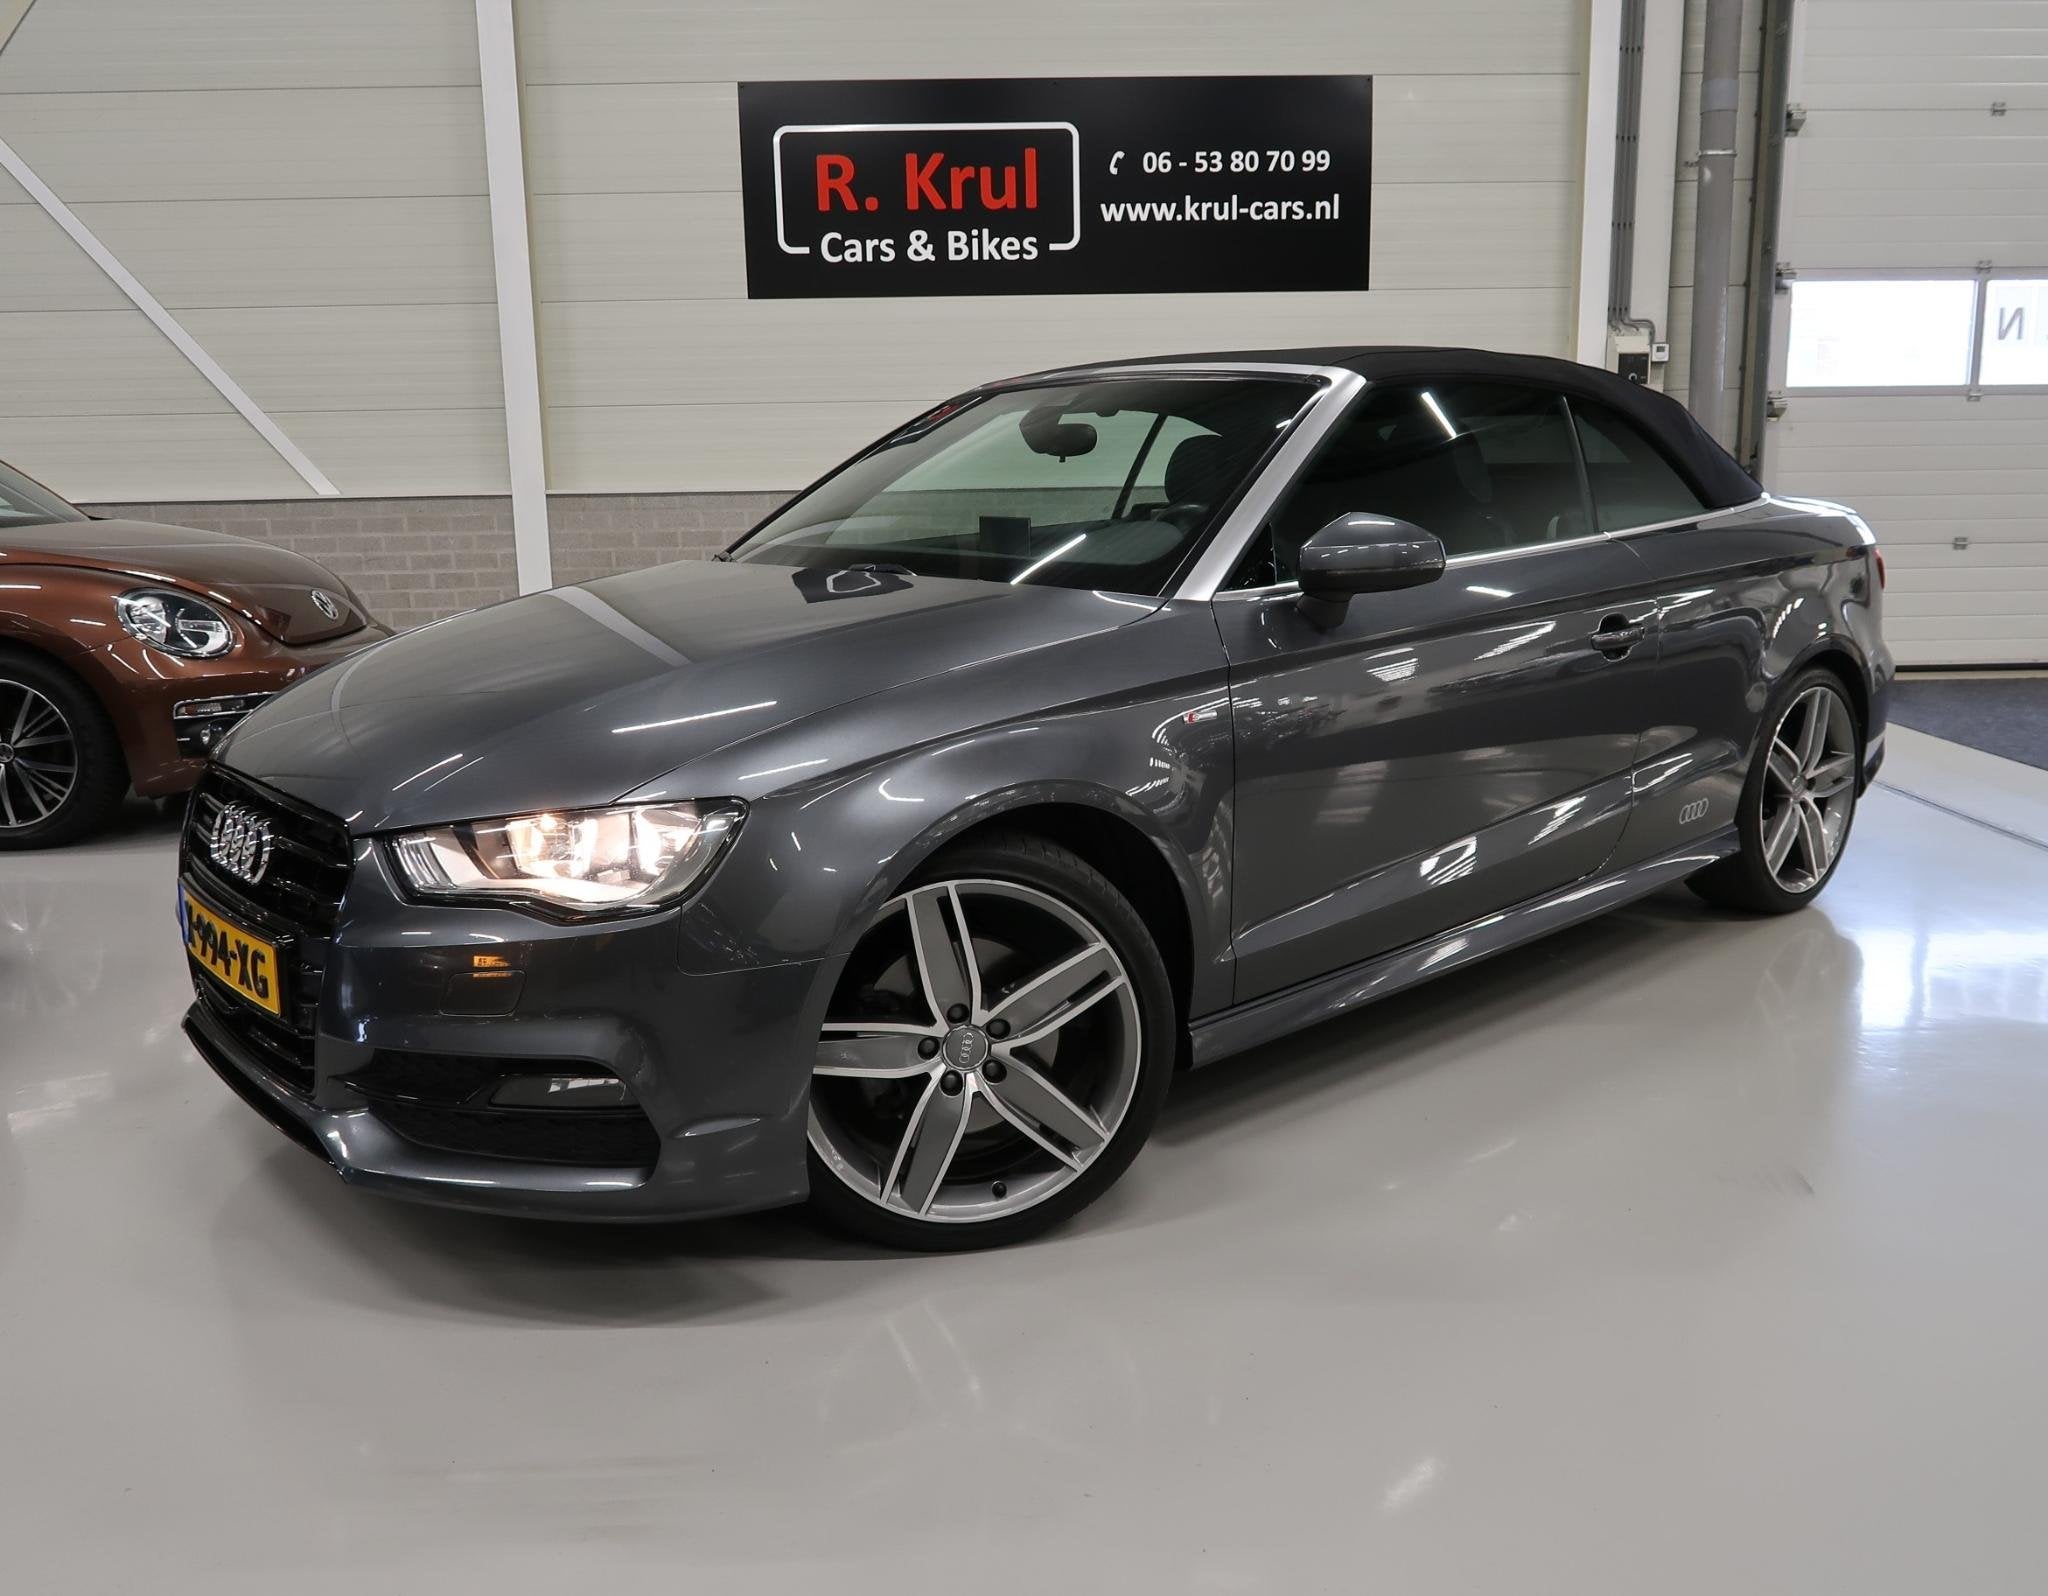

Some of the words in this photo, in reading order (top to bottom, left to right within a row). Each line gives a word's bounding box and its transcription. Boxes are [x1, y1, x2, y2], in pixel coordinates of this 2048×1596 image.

[1143, 151, 1172, 174] 06
[1194, 151, 1223, 173] 53
[1230, 151, 1260, 173] 80
[1267, 150, 1295, 172] 70
[1302, 150, 1332, 172] 99
[816, 154, 879, 212] R.
[906, 148, 1038, 211] Krul
[1100, 194, 1341, 221] www.krul-cars.nl
[821, 232, 897, 264] Cars
[907, 230, 937, 263] &
[948, 228, 1039, 261] Bikes
